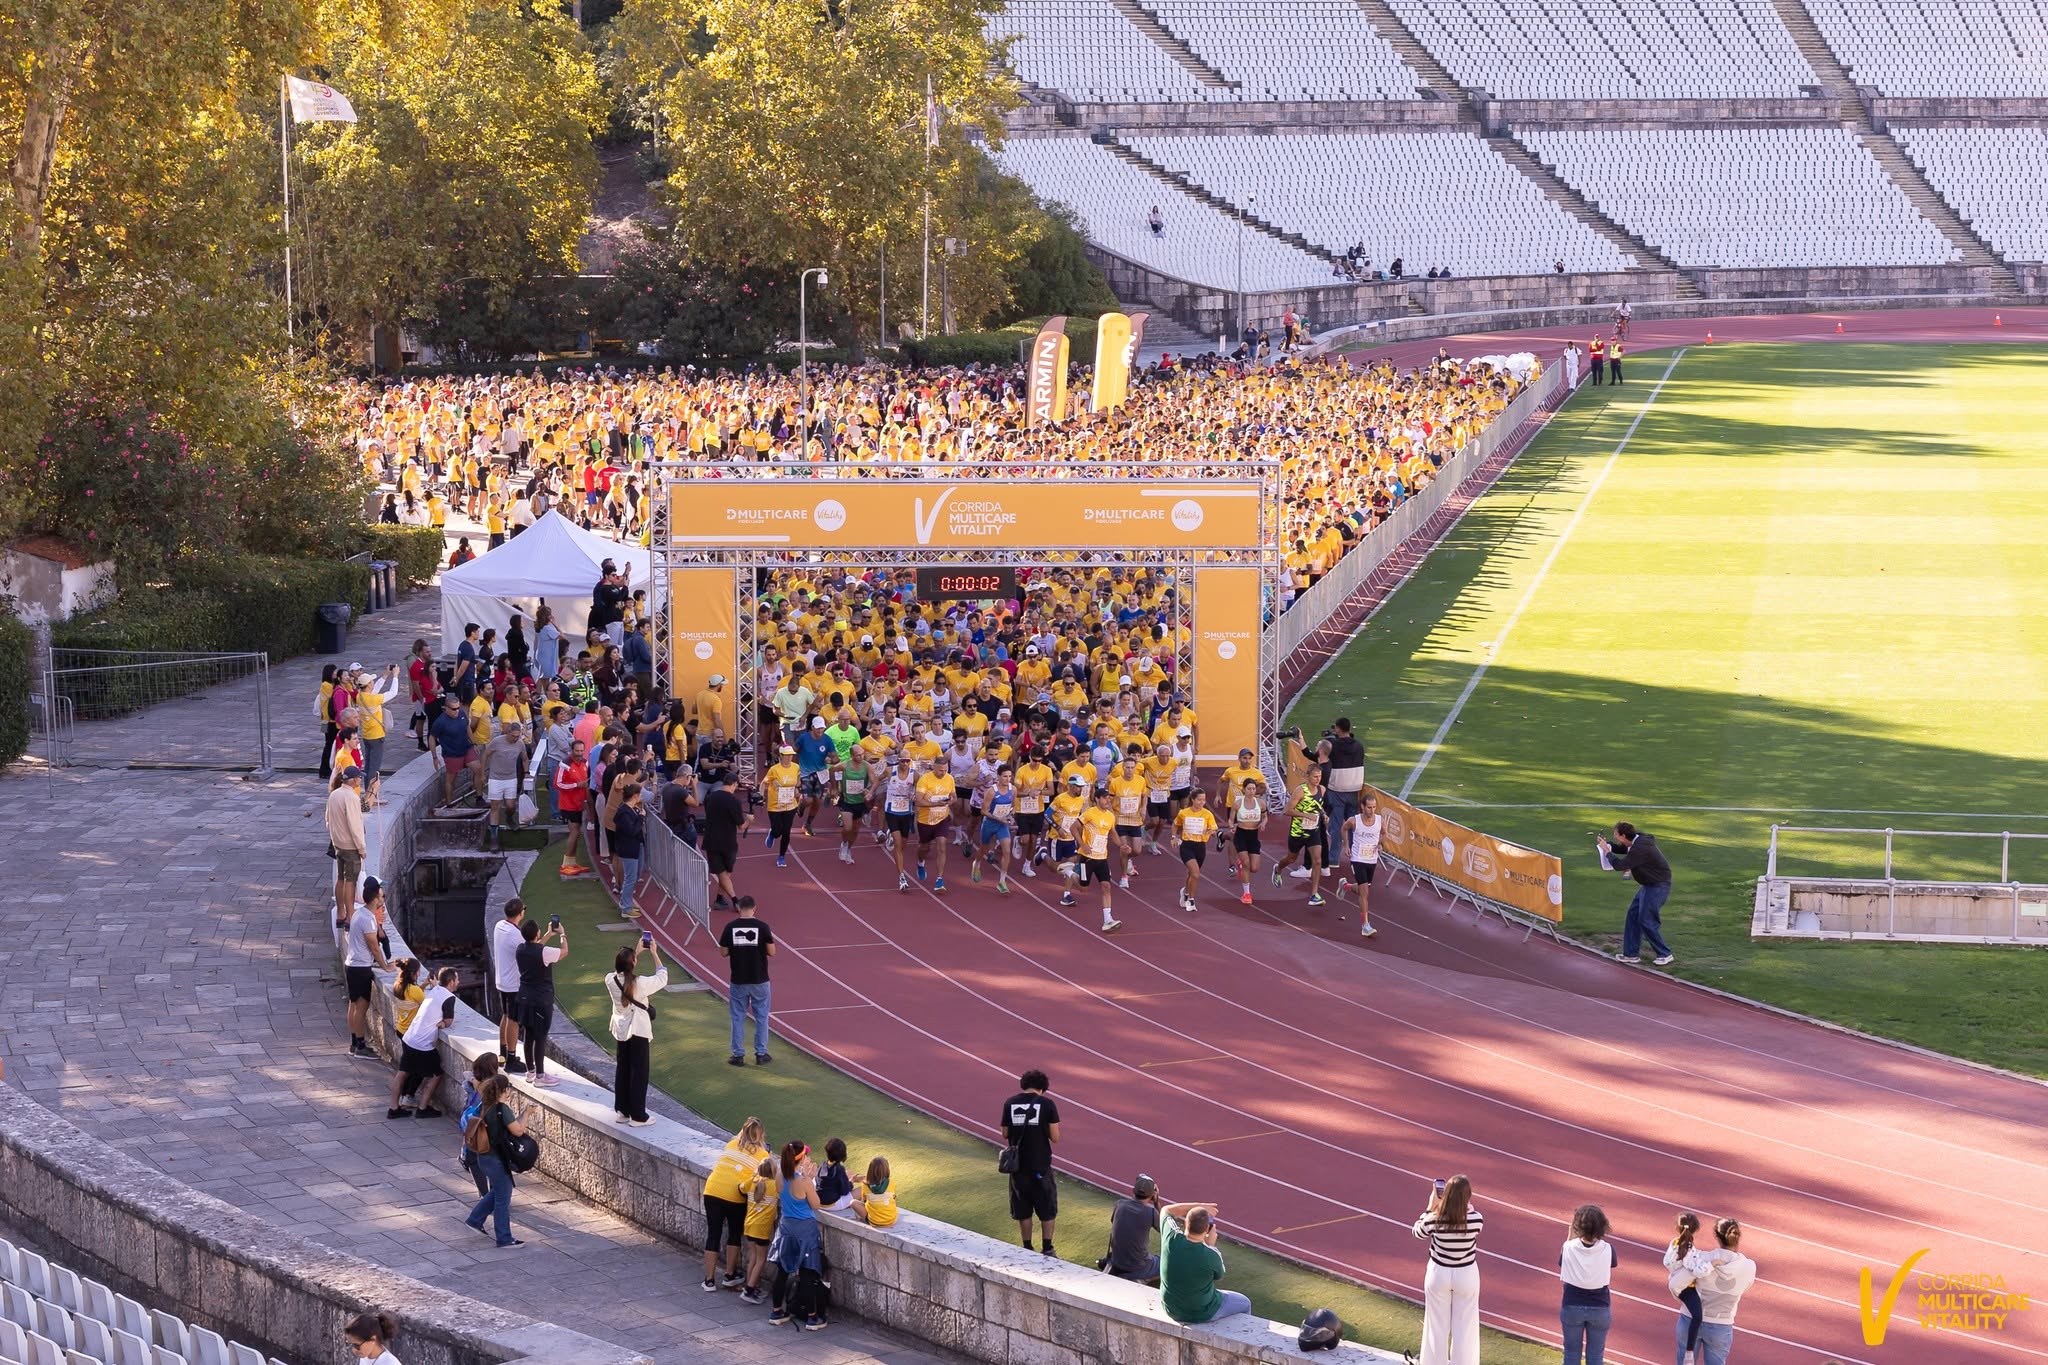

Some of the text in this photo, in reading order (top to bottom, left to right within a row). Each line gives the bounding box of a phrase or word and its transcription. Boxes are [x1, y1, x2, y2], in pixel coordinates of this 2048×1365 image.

[949, 501, 1003, 513] CORRIDA
[738, 509, 808, 520] MULTICARE
[949, 513, 1016, 524] MULTICARE
[1095, 509, 1165, 520] MULTICARE
[949, 524, 1003, 535] VITALITY
[941, 576, 1000, 591] 0:00:02
